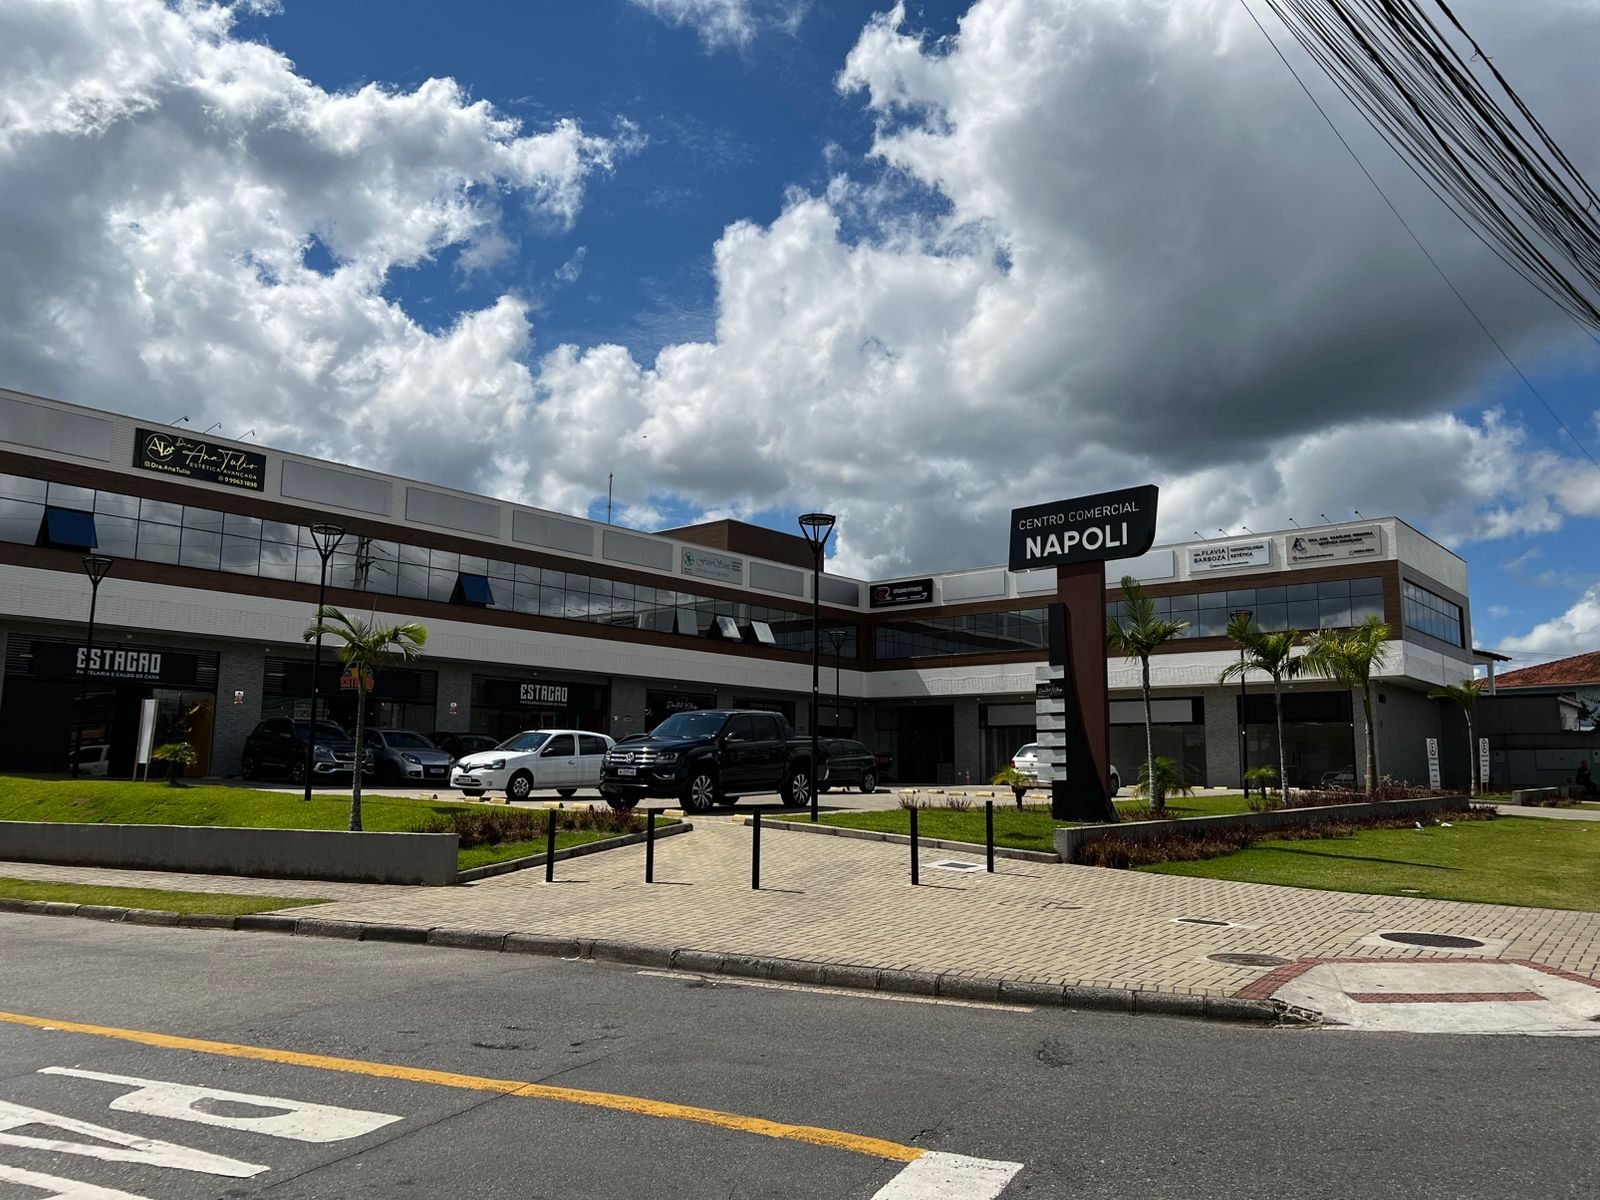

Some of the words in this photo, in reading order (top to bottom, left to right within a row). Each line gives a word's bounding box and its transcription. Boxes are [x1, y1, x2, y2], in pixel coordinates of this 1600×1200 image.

[182, 444, 222, 465] Ana
[1019, 513, 1065, 530] CENTRO
[1068, 501, 1140, 522] COMERCIAL
[1026, 522, 1128, 559] NAPOLI
[1193, 555, 1227, 563] BARBOZA
[76, 669, 110, 677] PATELARIA
